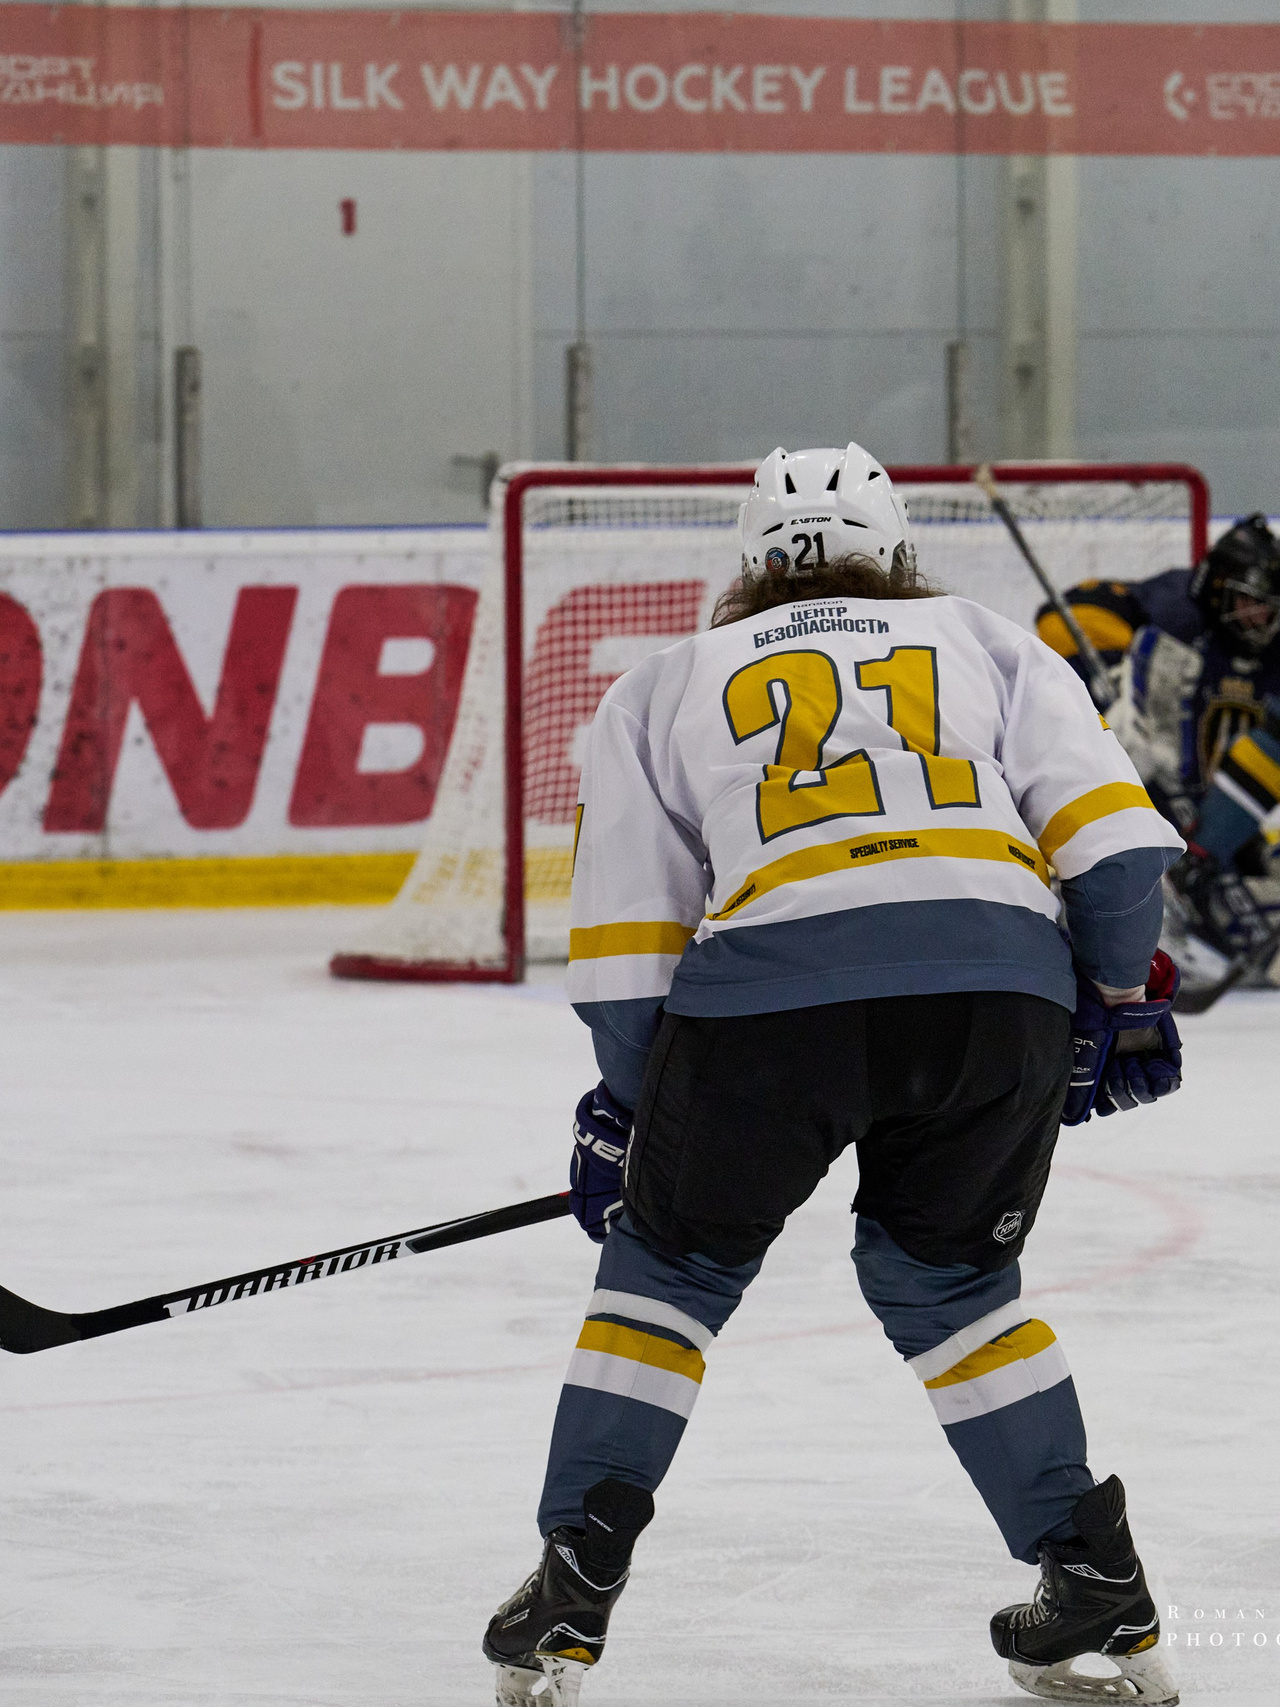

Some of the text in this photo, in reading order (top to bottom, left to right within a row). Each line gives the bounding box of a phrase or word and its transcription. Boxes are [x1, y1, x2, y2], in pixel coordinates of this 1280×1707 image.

[273, 62, 1074, 116] SILK WAY HOCKEY LEAGUE
[340, 198, 357, 236] 1
[791, 517, 831, 525] EASTON
[792, 532, 828, 570] 21
[753, 618, 889, 648] БЕЗОПАСНОСТИ
[790, 607, 847, 622] ЦЕНТР
[722, 645, 982, 845] 21
[849, 838, 919, 859] SPECIALTY SERVICE
[186, 1241, 402, 1313] WARRIOR
